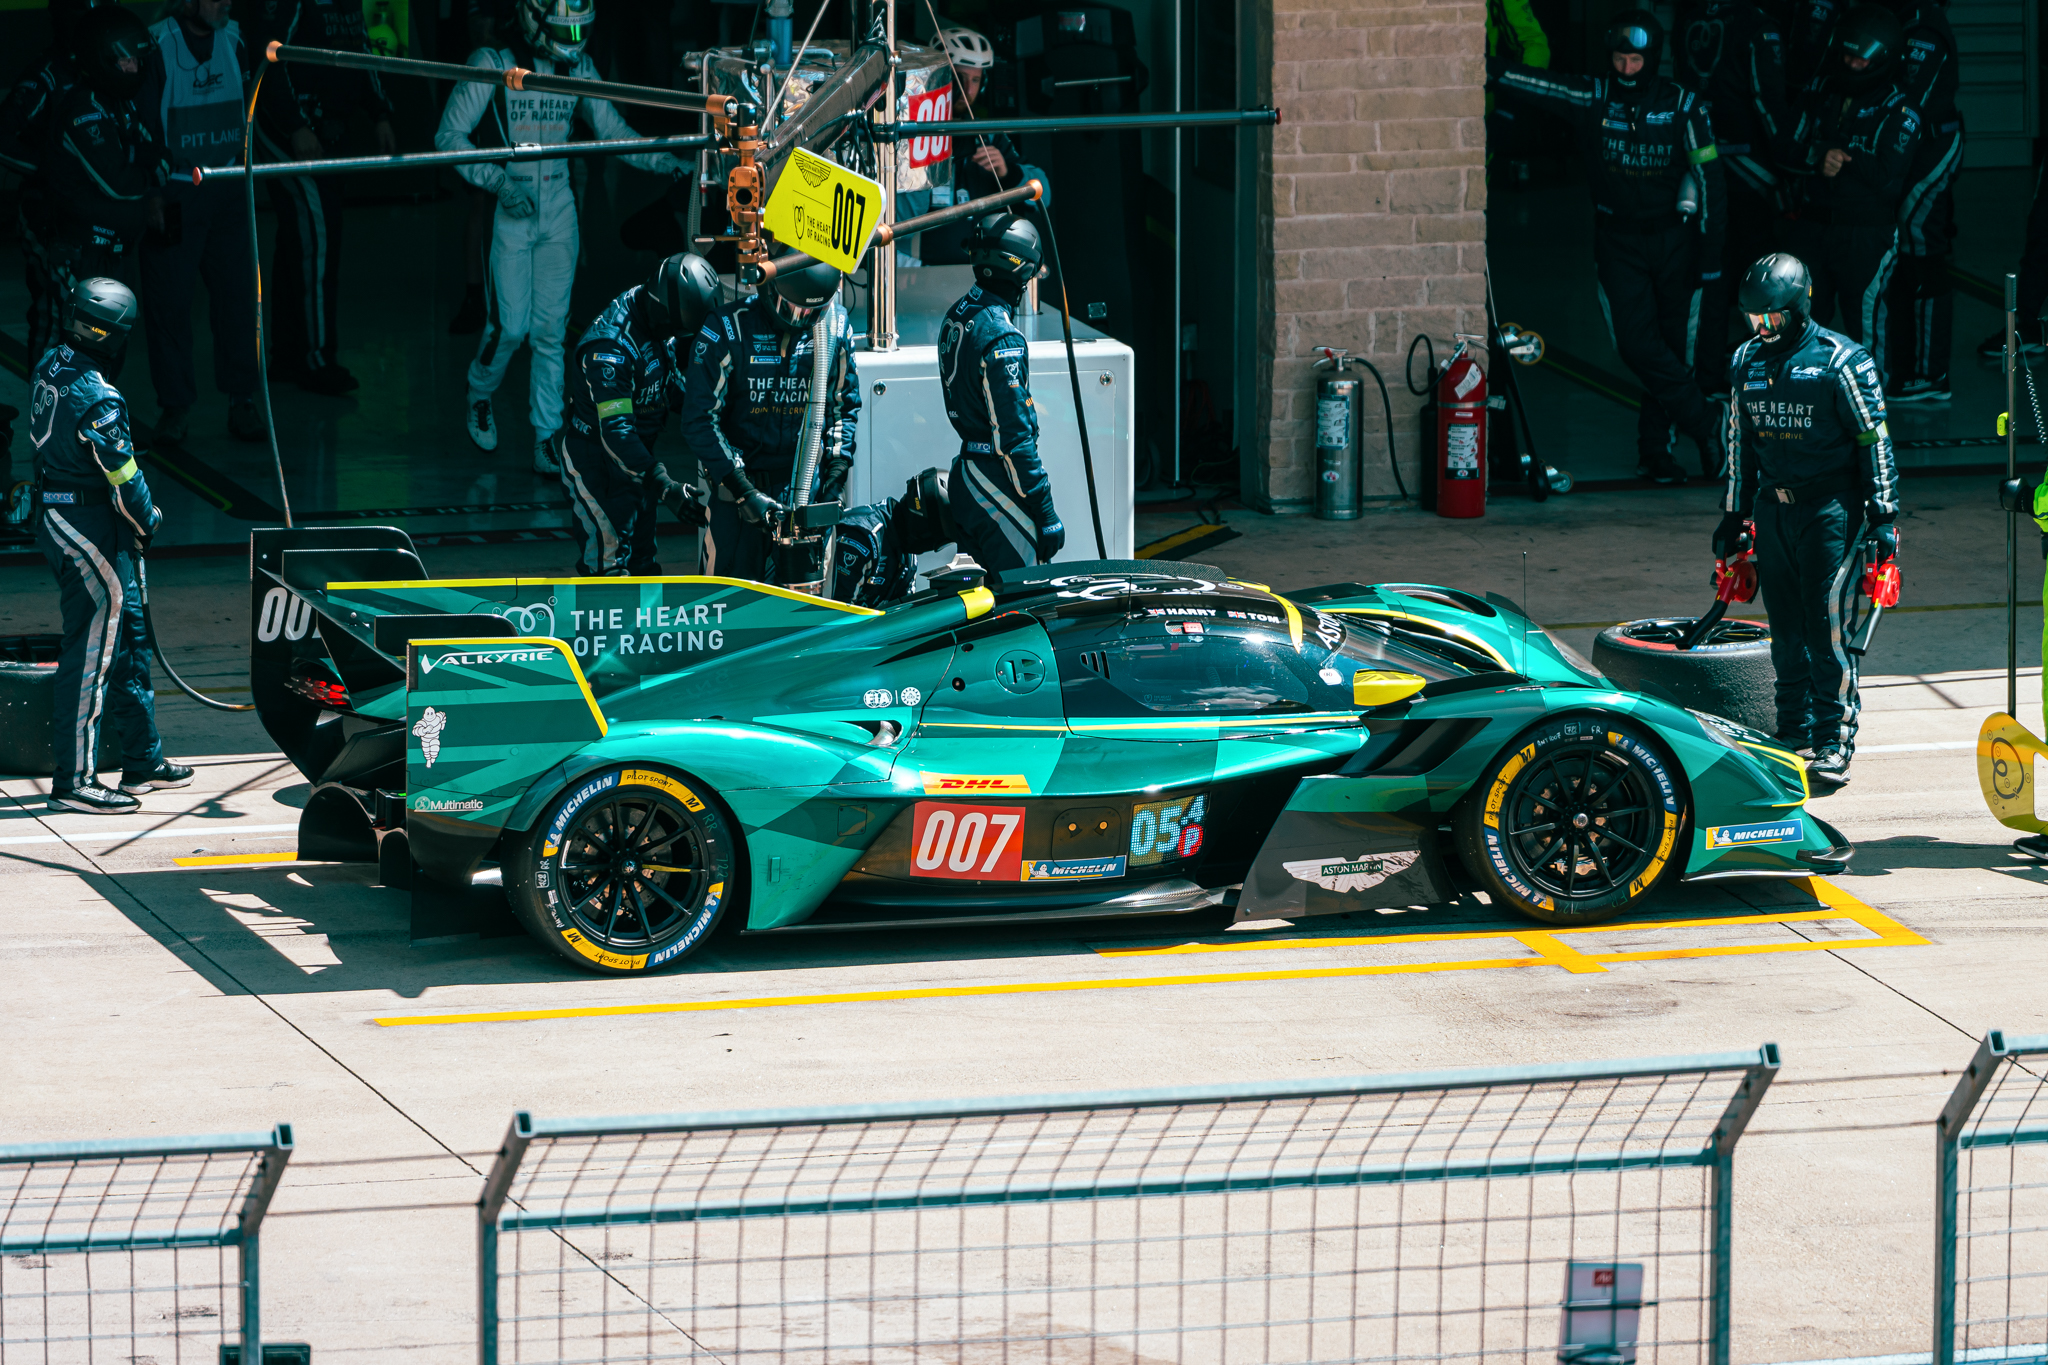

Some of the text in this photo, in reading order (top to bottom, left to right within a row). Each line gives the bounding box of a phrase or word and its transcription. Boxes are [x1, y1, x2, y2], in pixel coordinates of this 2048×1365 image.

[510, 99, 575, 110] THE HEART
[511, 110, 572, 121] OF RACING
[1646, 111, 1675, 119] WEC
[912, 87, 953, 162] 007
[181, 127, 241, 149] PIT LANE
[1602, 136, 1673, 156] THE HEART
[1622, 154, 1671, 167] RACING
[807, 215, 831, 236] THE HEART
[832, 182, 866, 260] 007
[807, 228, 831, 248] OF RACING
[1008, 255, 1022, 266] JACK
[722, 315, 735, 341] sparco
[837, 314, 846, 339] sparco
[1791, 365, 1823, 377] WEC
[640, 380, 660, 394] THE
[748, 377, 811, 390] THE HEA
[636, 394, 654, 406] OF
[749, 390, 766, 402] OF
[750, 406, 769, 414] JOIN
[771, 406, 786, 415] THE
[1747, 401, 1814, 416] THE HEART
[1765, 415, 1812, 428] RACING
[1780, 432, 1804, 440] DRIVE
[436, 503, 550, 514] HEART
[257, 586, 322, 643] 00
[571, 602, 728, 631] THE HEART
[1166, 607, 1217, 617] HARRY
[1247, 612, 1281, 624] TOM
[1315, 611, 1343, 650] ASTON
[573, 629, 725, 658] OF RACING
[420, 646, 556, 675] VALKYRIE
[865, 692, 892, 705] FIA
[1520, 747, 1532, 761] M
[626, 773, 674, 789] PILOT SPORT
[1632, 743, 1676, 806] MICHELIN
[939, 778, 1011, 789] DHL
[430, 798, 484, 811] Multimatic
[555, 775, 613, 832] MICHELIN
[685, 796, 699, 810] M
[702, 812, 719, 834] RR
[915, 809, 1021, 873] 007
[1733, 825, 1796, 842] MICHELIN
[715, 852, 730, 879] 722
[1050, 862, 1118, 876] MICHELIN
[1322, 864, 1350, 875] ASTON
[1486, 832, 1533, 902] MICHELIN
[1632, 878, 1643, 893] M
[566, 931, 582, 944] M
[653, 907, 713, 965] MICHELIN
[593, 951, 641, 967] PILOT SPORT
